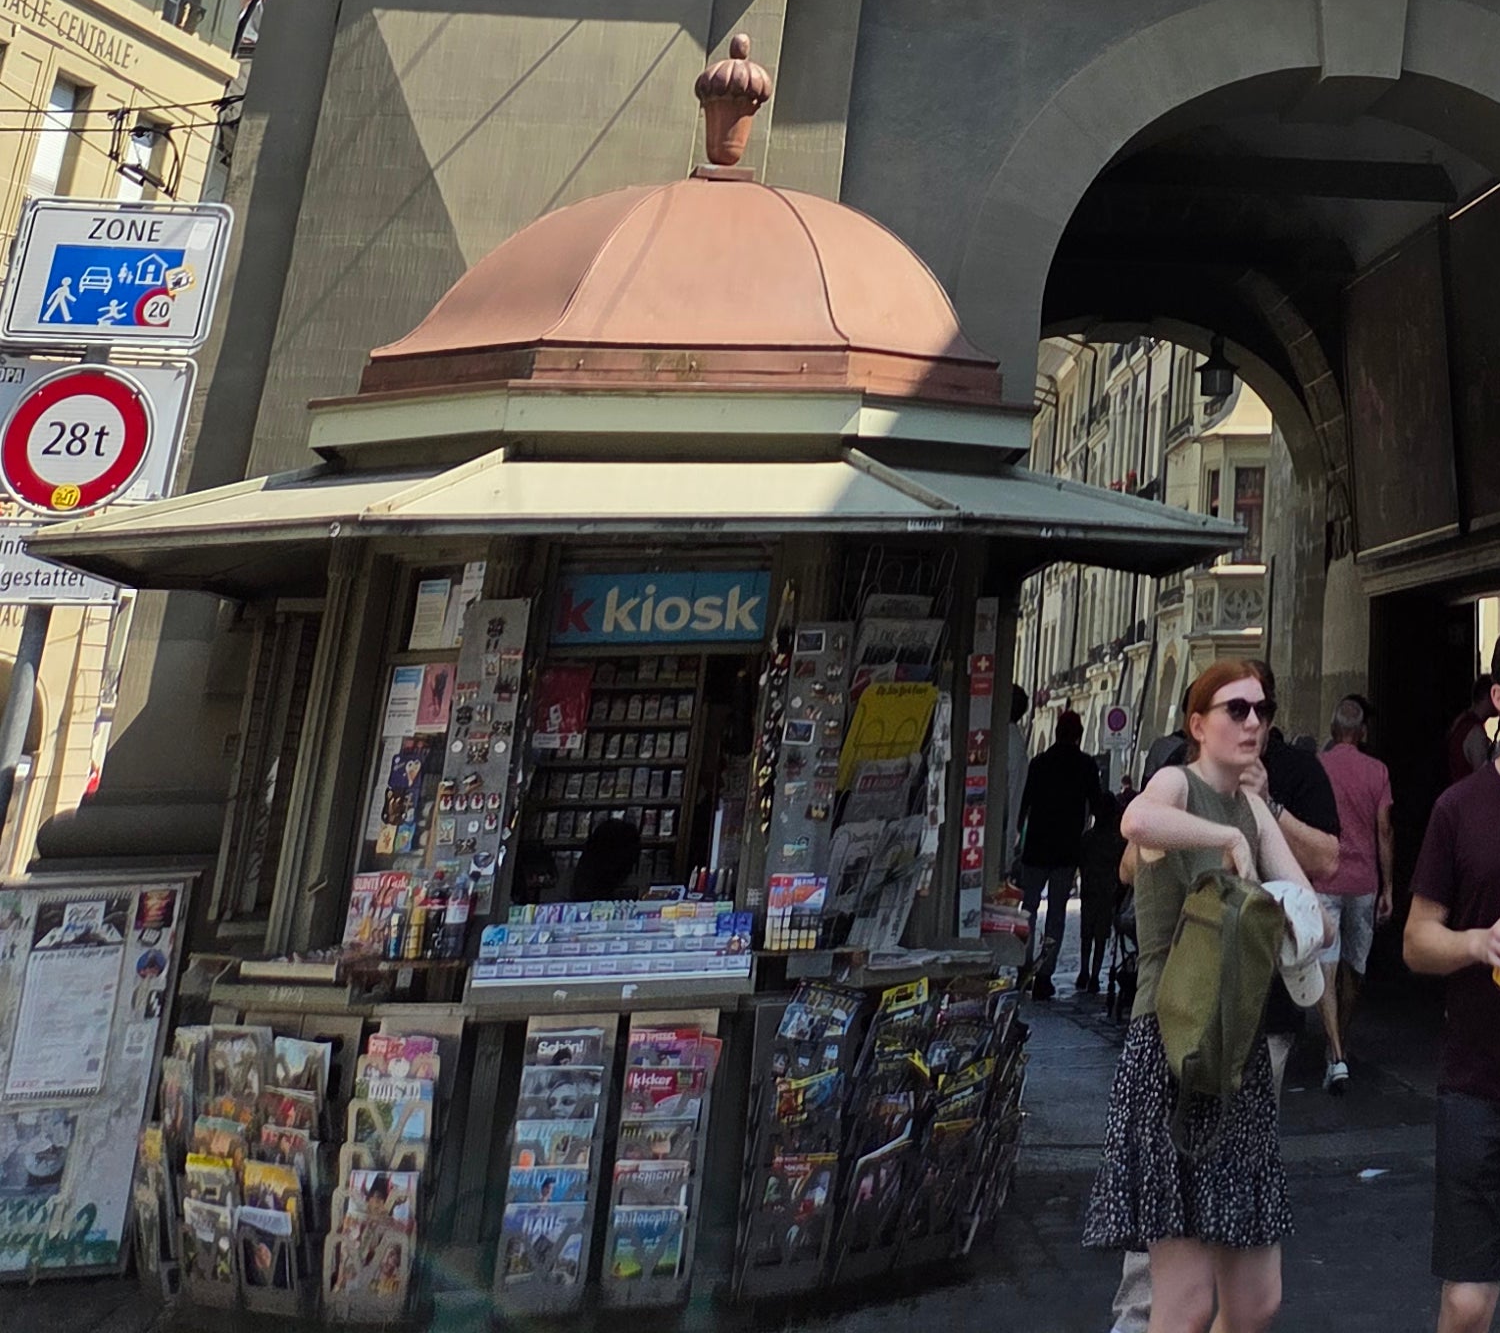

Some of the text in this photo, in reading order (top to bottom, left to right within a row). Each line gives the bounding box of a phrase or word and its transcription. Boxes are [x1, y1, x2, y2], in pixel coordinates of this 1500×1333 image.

[87, 217, 164, 244] ZONE
[148, 300, 170, 318] 20
[601, 583, 761, 635] kiosk
